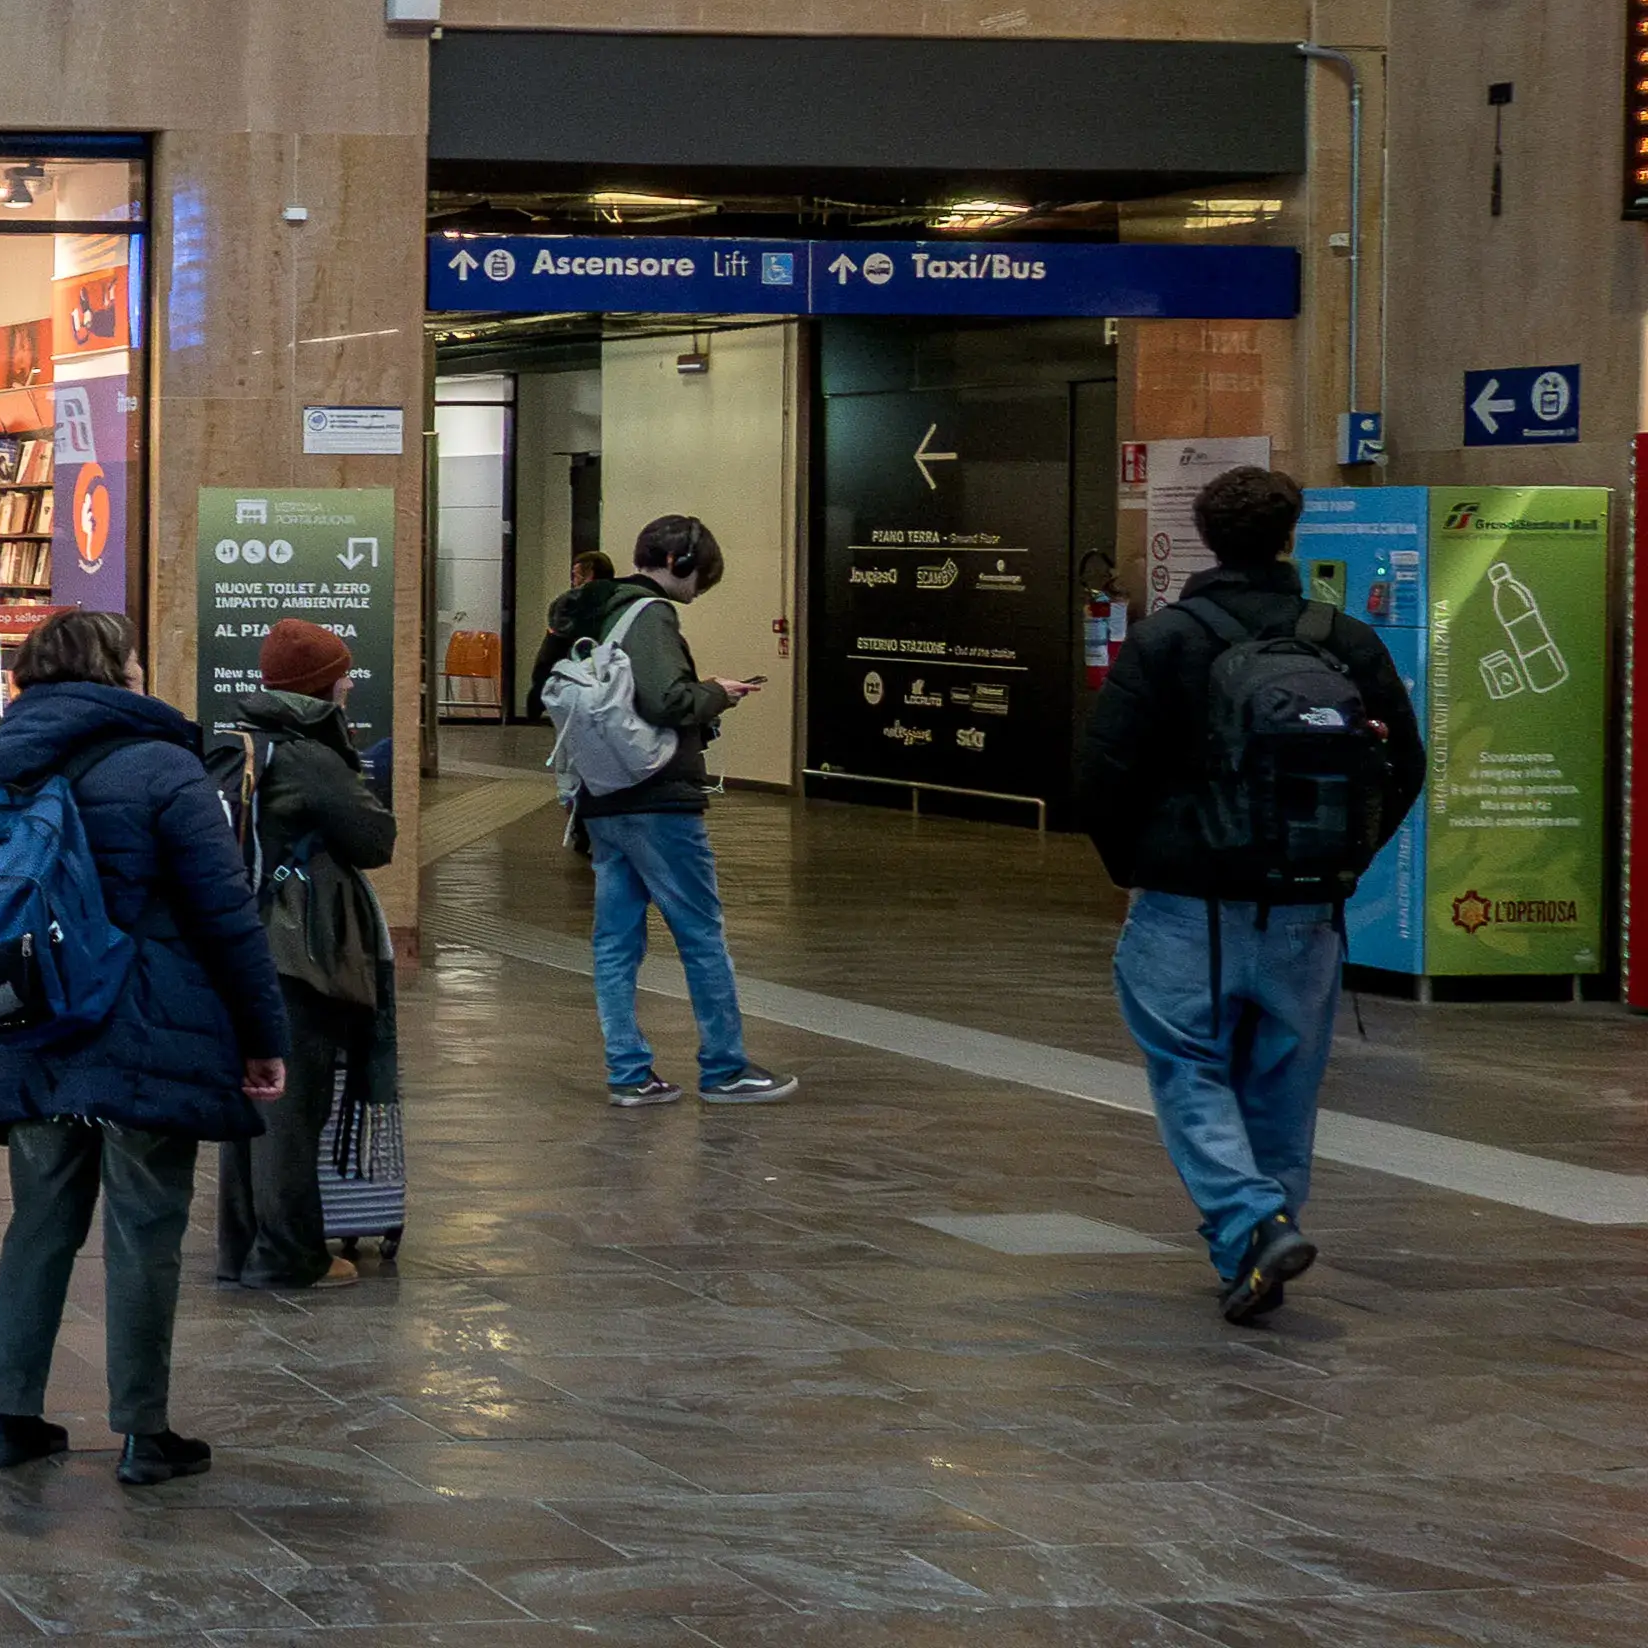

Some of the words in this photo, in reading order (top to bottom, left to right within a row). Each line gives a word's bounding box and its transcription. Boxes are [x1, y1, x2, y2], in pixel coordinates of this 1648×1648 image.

[531, 249, 696, 278] Ascensore
[713, 250, 749, 278] Lift
[912, 252, 1047, 281] Taxi/Bus
[871, 530, 904, 542] PIANO
[907, 530, 940, 543] TERRA
[215, 583, 263, 594] NUOVE
[267, 583, 316, 594] TOILET
[319, 583, 330, 594] A
[333, 583, 372, 594] ZERO
[215, 597, 278, 609] IMPATTO
[282, 597, 371, 609] AMBIENTALE
[214, 624, 237, 637] AL
[241, 624, 272, 637] PIA
[856, 636, 898, 651] ESTERNO
[899, 639, 946, 655] STAZIONE
[214, 667, 244, 679] New
[214, 684, 231, 693] on
[235, 682, 257, 693] the
